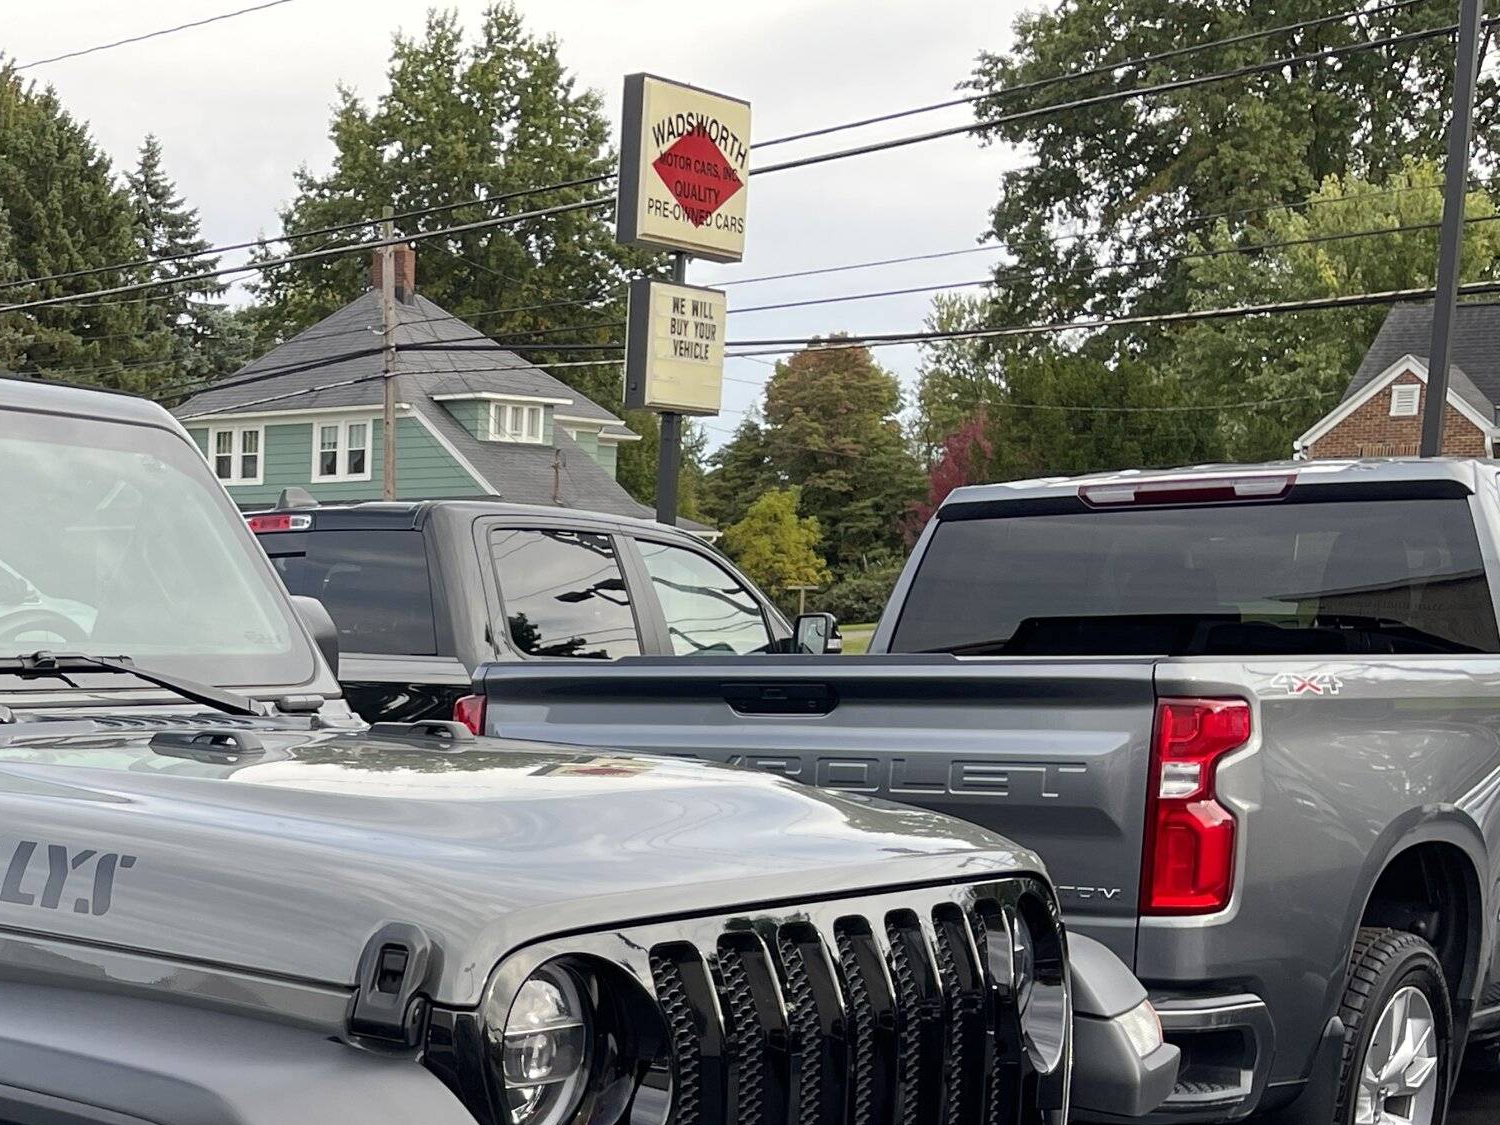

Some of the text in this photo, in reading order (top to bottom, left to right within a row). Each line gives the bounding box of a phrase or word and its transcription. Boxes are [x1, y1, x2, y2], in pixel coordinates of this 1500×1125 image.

[652, 112, 747, 169] WADSWORTH
[660, 151, 692, 171] MOTOR
[674, 180, 720, 204] QUALITY
[648, 198, 744, 234] PRE-OWNED CARS
[672, 296, 714, 320] WE WILL
[670, 317, 717, 341] BUY YOUR
[673, 339, 709, 360] VEHICLE
